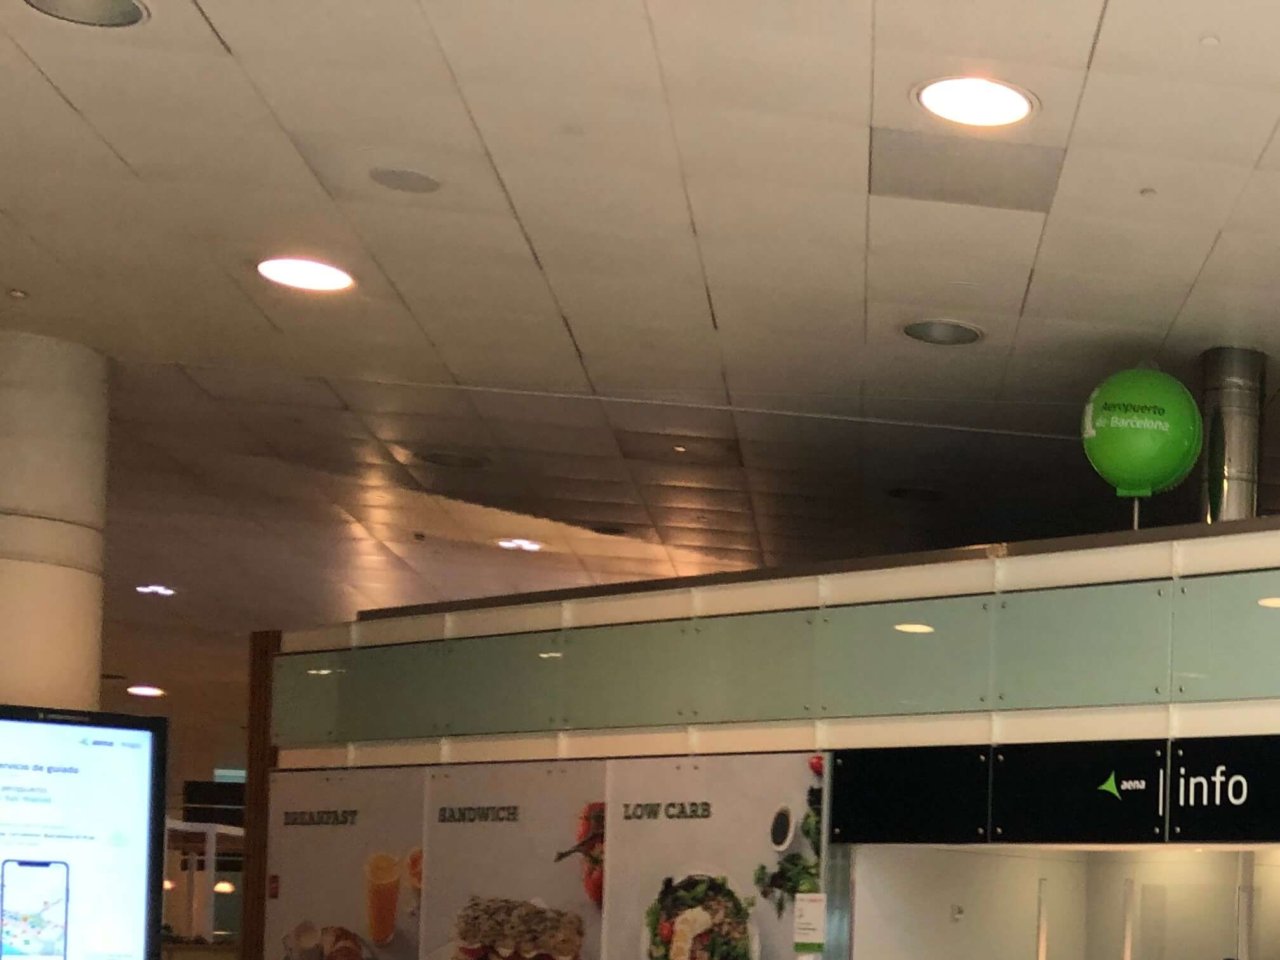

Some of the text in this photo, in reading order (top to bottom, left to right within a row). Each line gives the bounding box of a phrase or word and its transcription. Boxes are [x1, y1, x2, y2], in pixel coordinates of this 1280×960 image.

[1102, 402, 1166, 416] Aeropuerto
[1111, 416, 1169, 432] Barcelona
[1120, 765, 1248, 807] aena info
[283, 809, 358, 826] BREAKFAST
[438, 805, 519, 823] SANDWICH
[623, 801, 712, 820] LOW CARB
